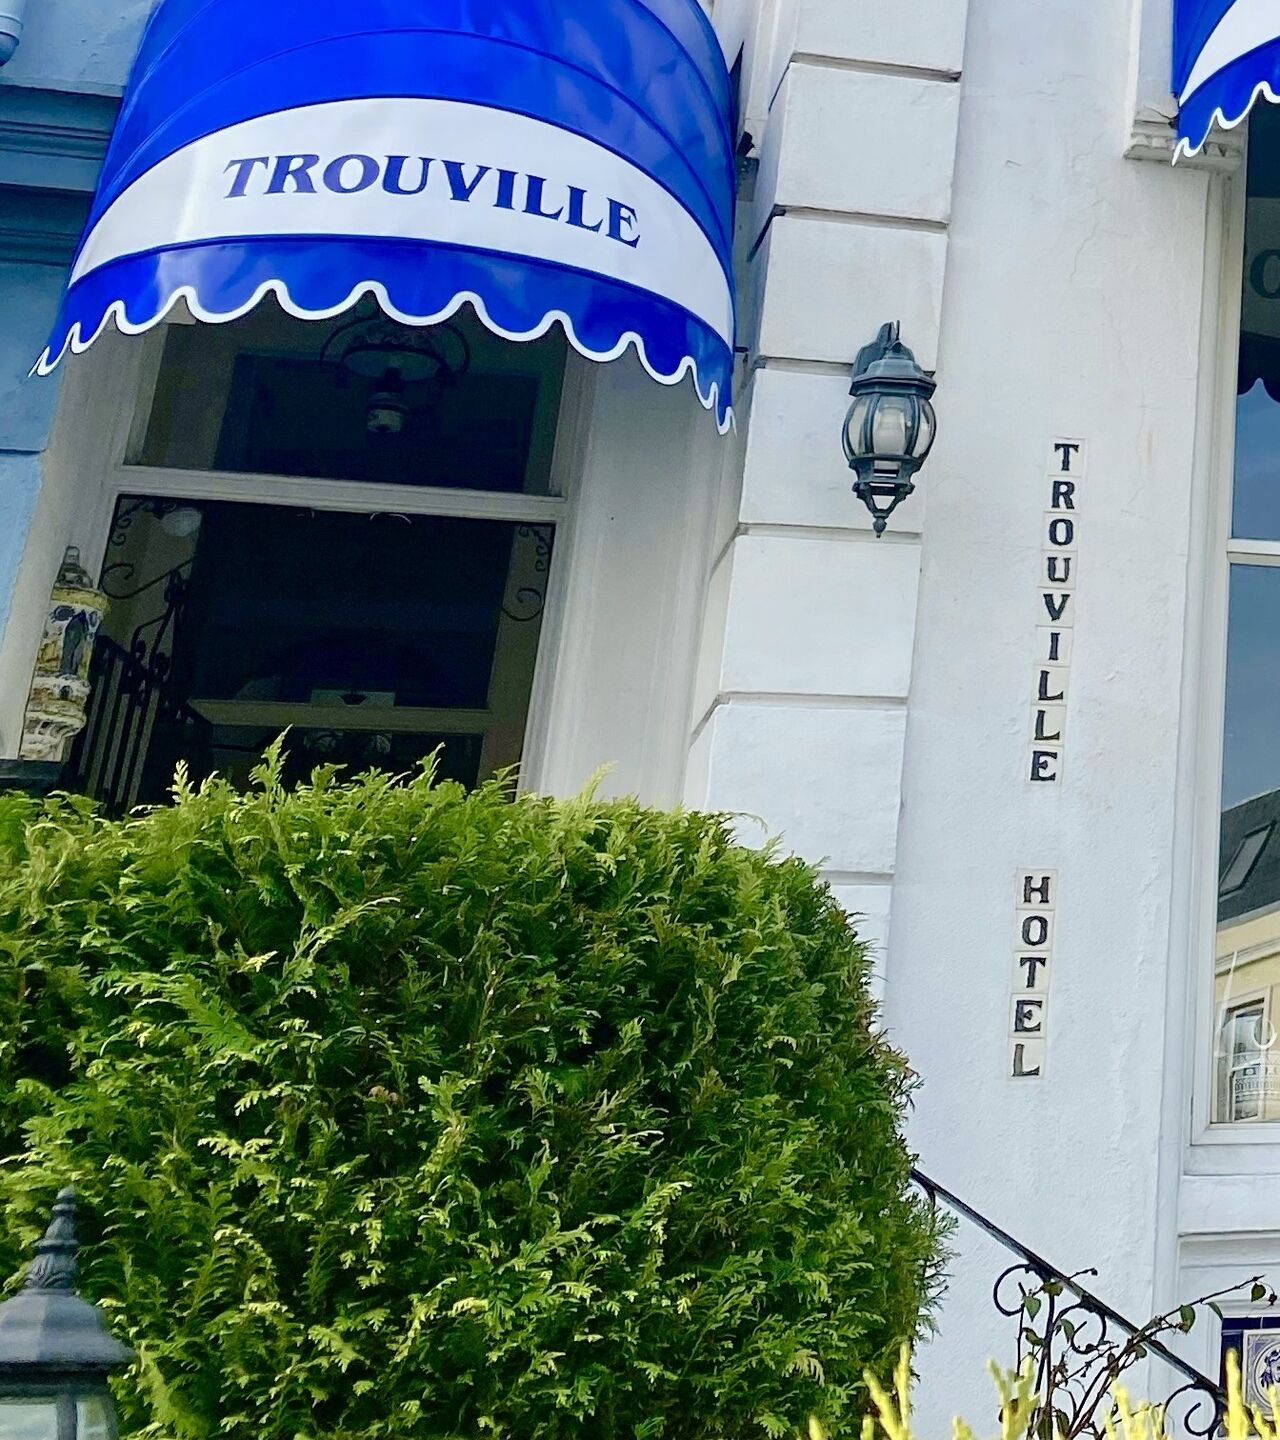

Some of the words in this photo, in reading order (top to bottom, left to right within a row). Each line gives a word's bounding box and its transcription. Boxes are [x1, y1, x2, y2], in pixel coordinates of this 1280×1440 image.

[222, 153, 642, 249] TROUVILLE
[1029, 442, 1080, 783] TROUVILLE
[1009, 874, 1051, 1079] HOTEL
